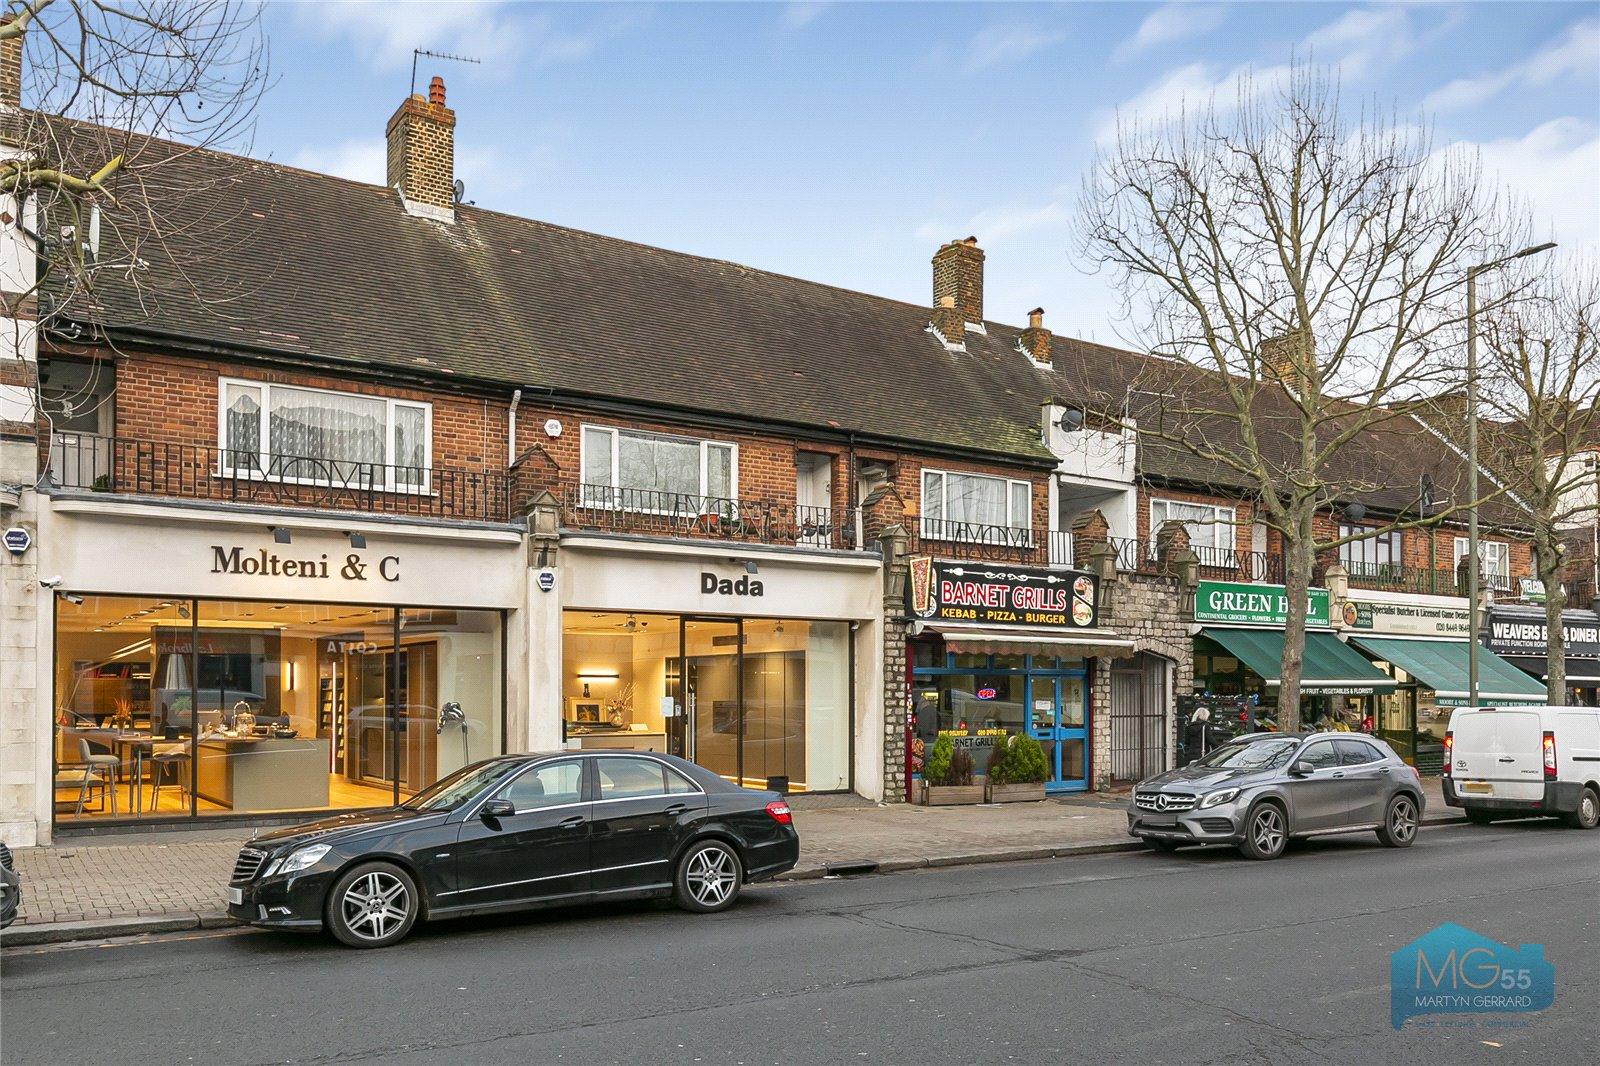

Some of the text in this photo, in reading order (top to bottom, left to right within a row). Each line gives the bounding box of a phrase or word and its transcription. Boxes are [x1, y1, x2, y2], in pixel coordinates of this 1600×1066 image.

[211, 545, 400, 582] Molteni & C
[700, 572, 764, 597] Dada
[942, 581, 1067, 612] BARNET GRILLS
[1208, 591, 1316, 615] GREEN HL
[941, 608, 977, 619] KEBAB
[987, 610, 1017, 621] PIZZA
[1025, 612, 1066, 624] BURGER
[1197, 612, 1227, 620] CONTINENTAL
[1372, 605, 1395, 616] Specialist
[1492, 623, 1540, 640] WEAVERS
[1562, 626, 1570, 640] &
[1570, 628, 1598, 643] DINER
[1491, 639, 1511, 647] PRIVATE
[1510, 640, 1534, 648] FUNCTION
